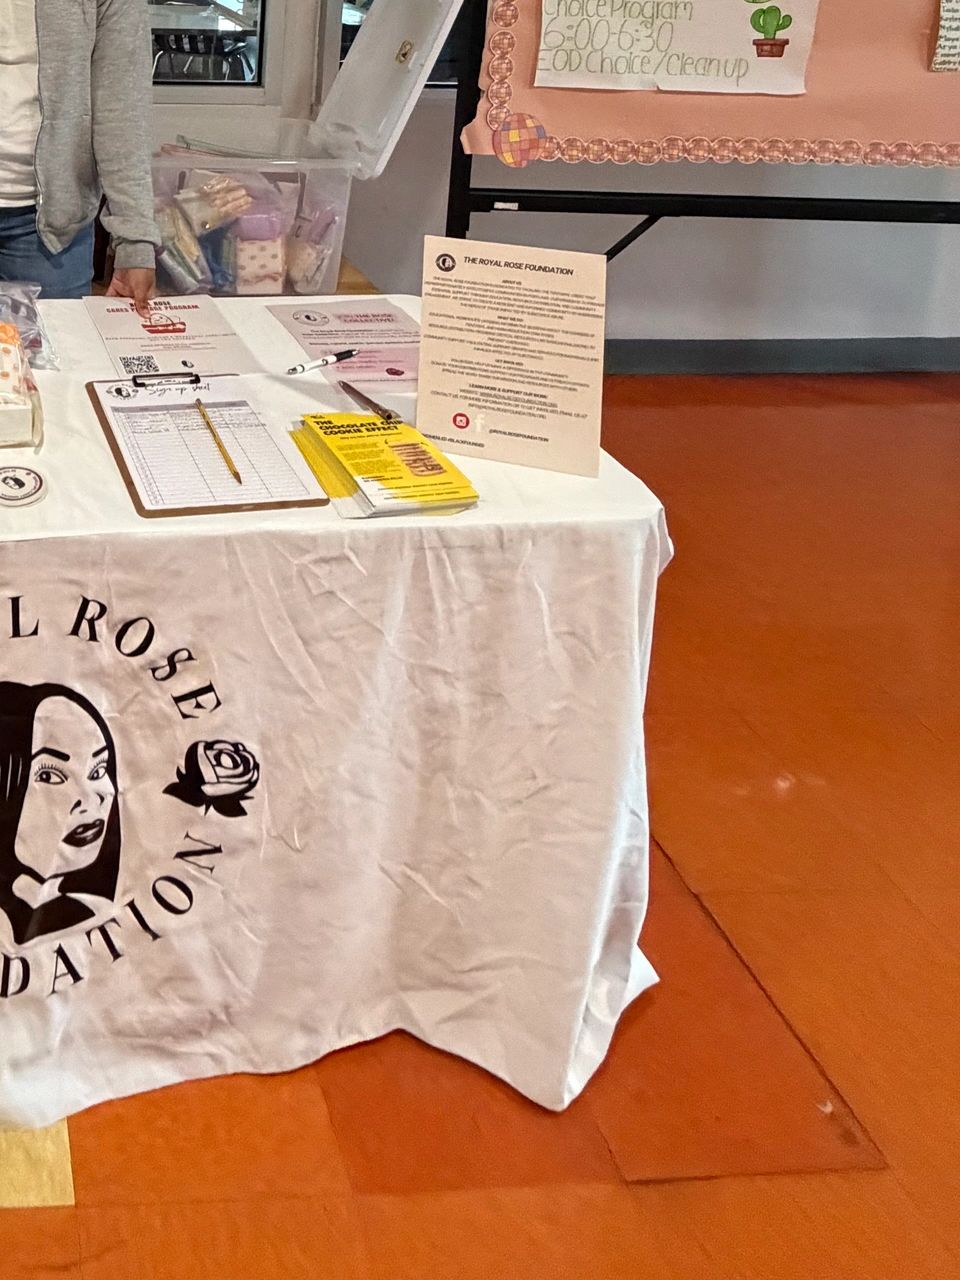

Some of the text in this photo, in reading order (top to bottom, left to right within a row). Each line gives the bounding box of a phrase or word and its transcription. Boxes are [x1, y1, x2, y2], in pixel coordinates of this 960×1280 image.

[543, 19, 674, 53] 6:00-6:30
[538, 48, 582, 72] EOD
[464, 256, 574, 276] THE ROYAL ROSE FOUNDATION
[319, 422, 379, 431] CHOCOLATE
[323, 428, 362, 436] COOKIE
[67, 595, 222, 721] ROSE
